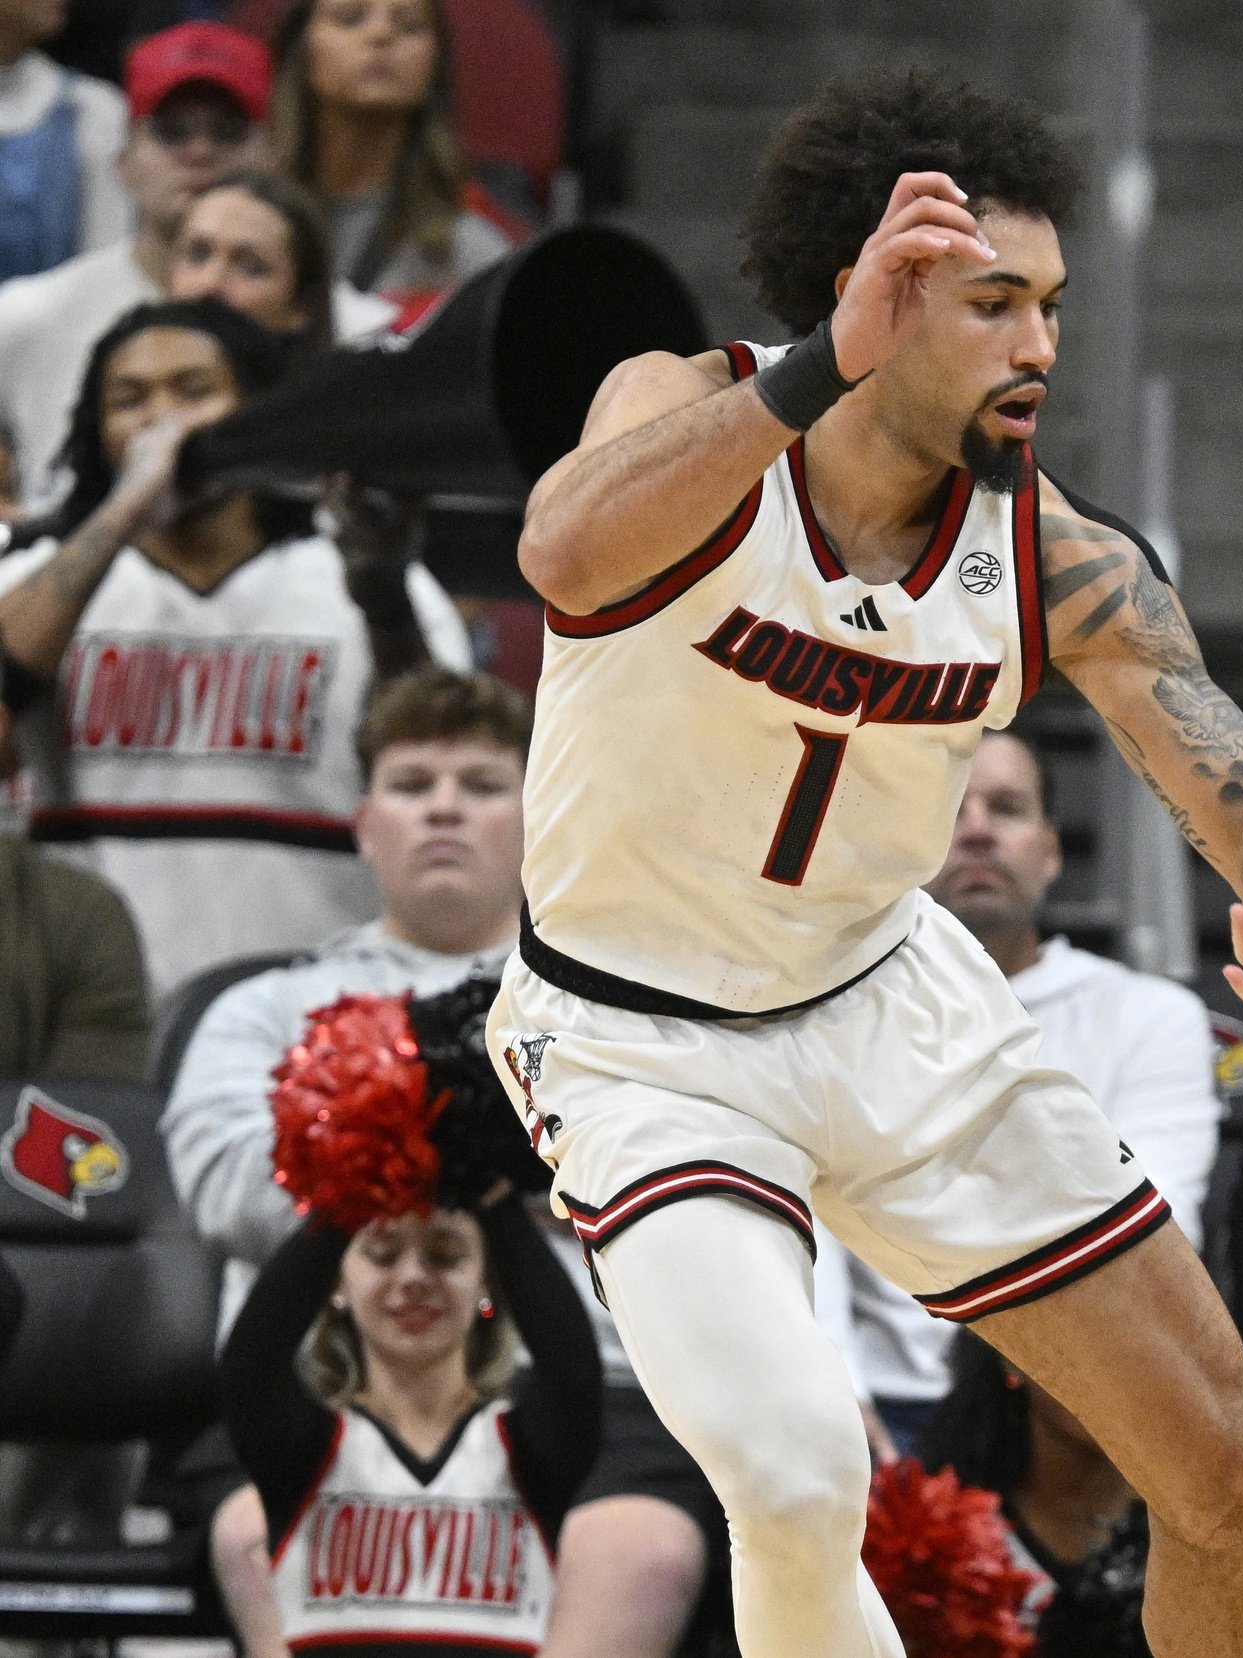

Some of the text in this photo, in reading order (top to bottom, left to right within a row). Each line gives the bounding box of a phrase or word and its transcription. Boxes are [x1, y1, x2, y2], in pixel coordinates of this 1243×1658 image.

[963, 565, 1001, 577] ACC
[67, 643, 322, 755] LOUISVILLE
[690, 605, 1003, 728] LOUISVILLE
[761, 721, 849, 886] 1
[309, 1503, 526, 1604] LOUISVILLE
